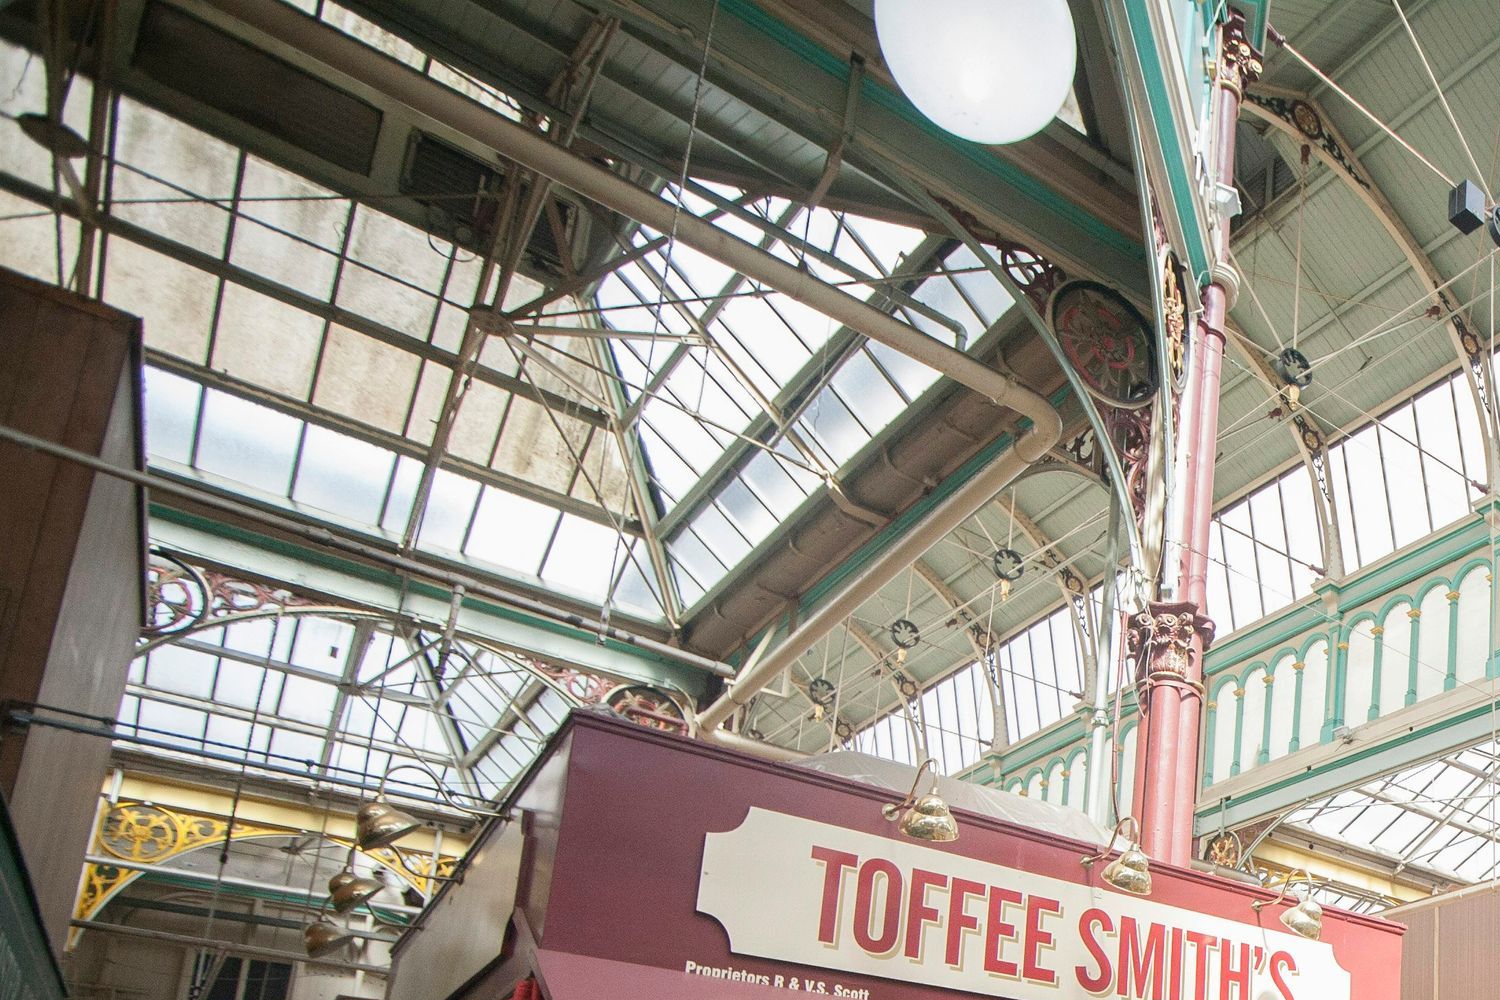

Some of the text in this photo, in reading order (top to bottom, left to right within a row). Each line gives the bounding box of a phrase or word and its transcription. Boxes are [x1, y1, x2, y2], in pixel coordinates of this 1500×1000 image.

[811, 845, 1064, 986] TOFFEE
[685, 959, 770, 986] Proprietors
[774, 974, 785, 989] R
[788, 976, 800, 991] &
[833, 983, 870, 1000] Scott
